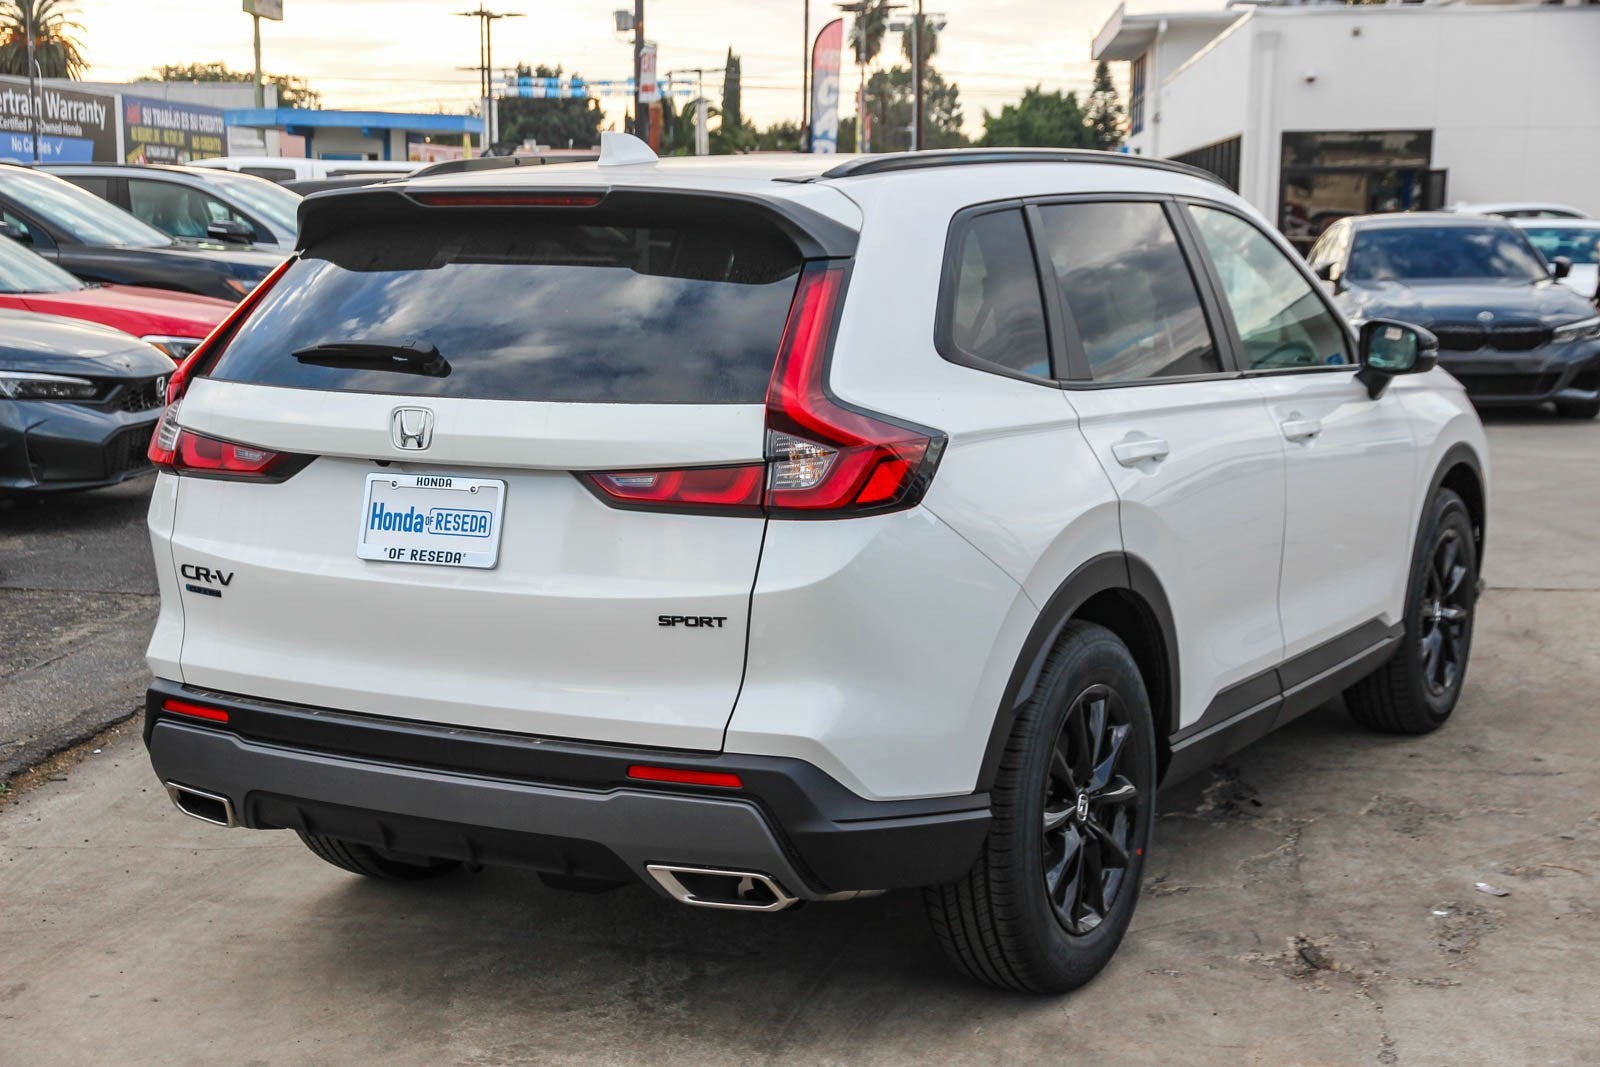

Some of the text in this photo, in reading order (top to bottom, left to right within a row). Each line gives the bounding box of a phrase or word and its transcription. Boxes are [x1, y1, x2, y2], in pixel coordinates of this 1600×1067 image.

[45, 90, 106, 131] Warranty
[142, 106, 152, 126] SU
[62, 122, 83, 137] Honda
[11, 135, 22, 153] No
[416, 476, 453, 488] HONDA
[370, 501, 488, 534] Honda OF RESEDA
[180, 563, 234, 586] CR-V
[658, 615, 728, 628] SPORT
